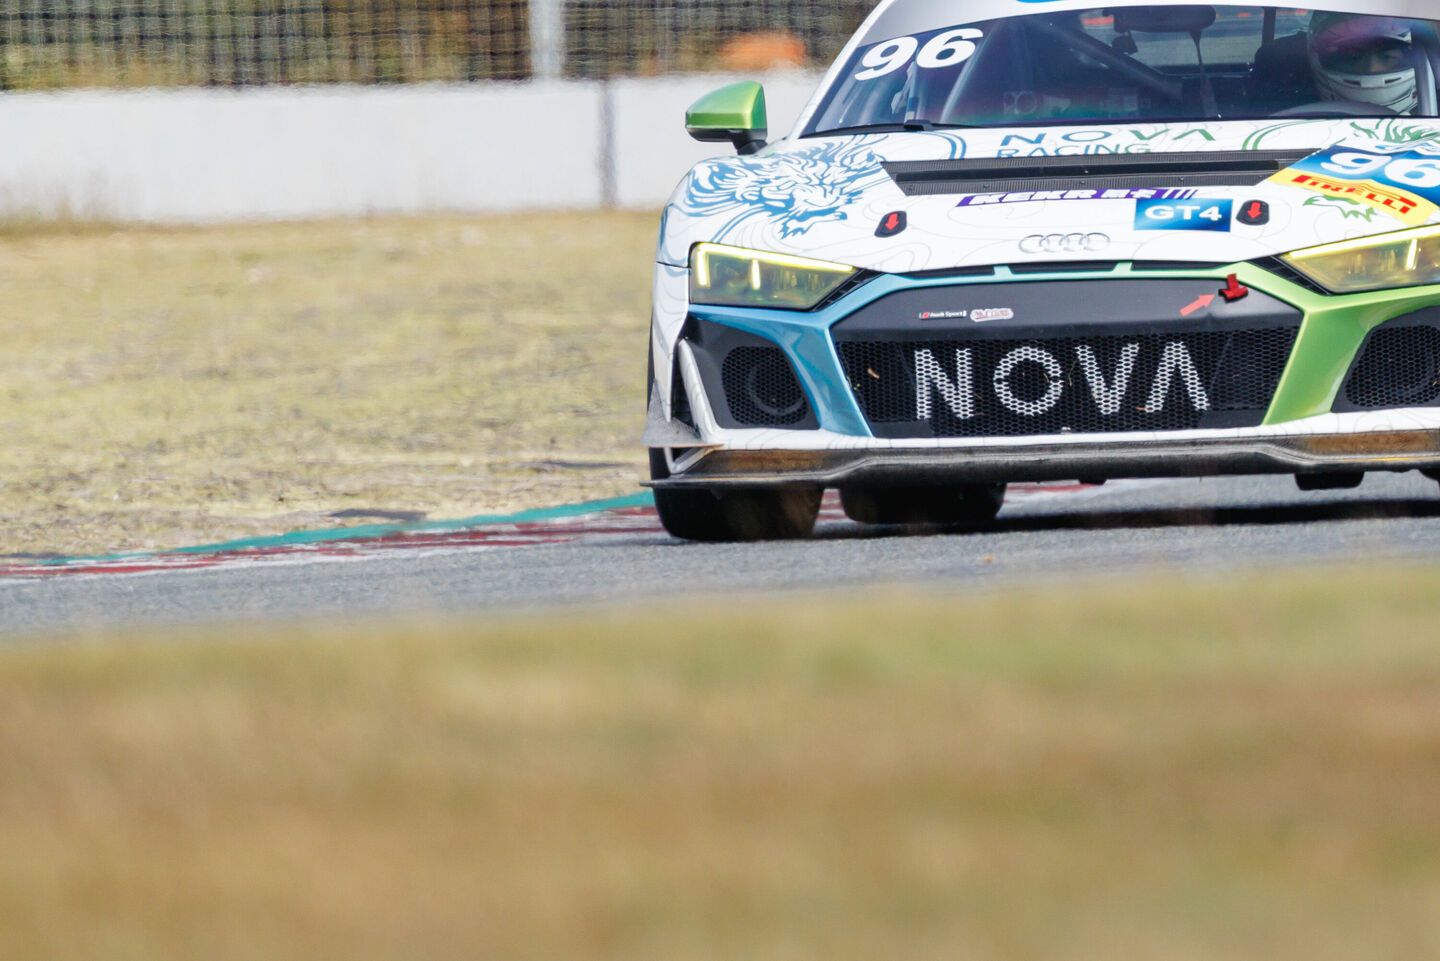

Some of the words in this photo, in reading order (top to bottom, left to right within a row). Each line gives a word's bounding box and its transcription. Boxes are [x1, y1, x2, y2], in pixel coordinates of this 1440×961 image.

[854, 28, 984, 81] 96
[996, 143, 1152, 159] RACING
[1000, 128, 1216, 147] NOVA
[1291, 174, 1418, 215] PIRELLI
[1145, 205, 1222, 221] GT4
[914, 341, 1211, 411] NOVA
